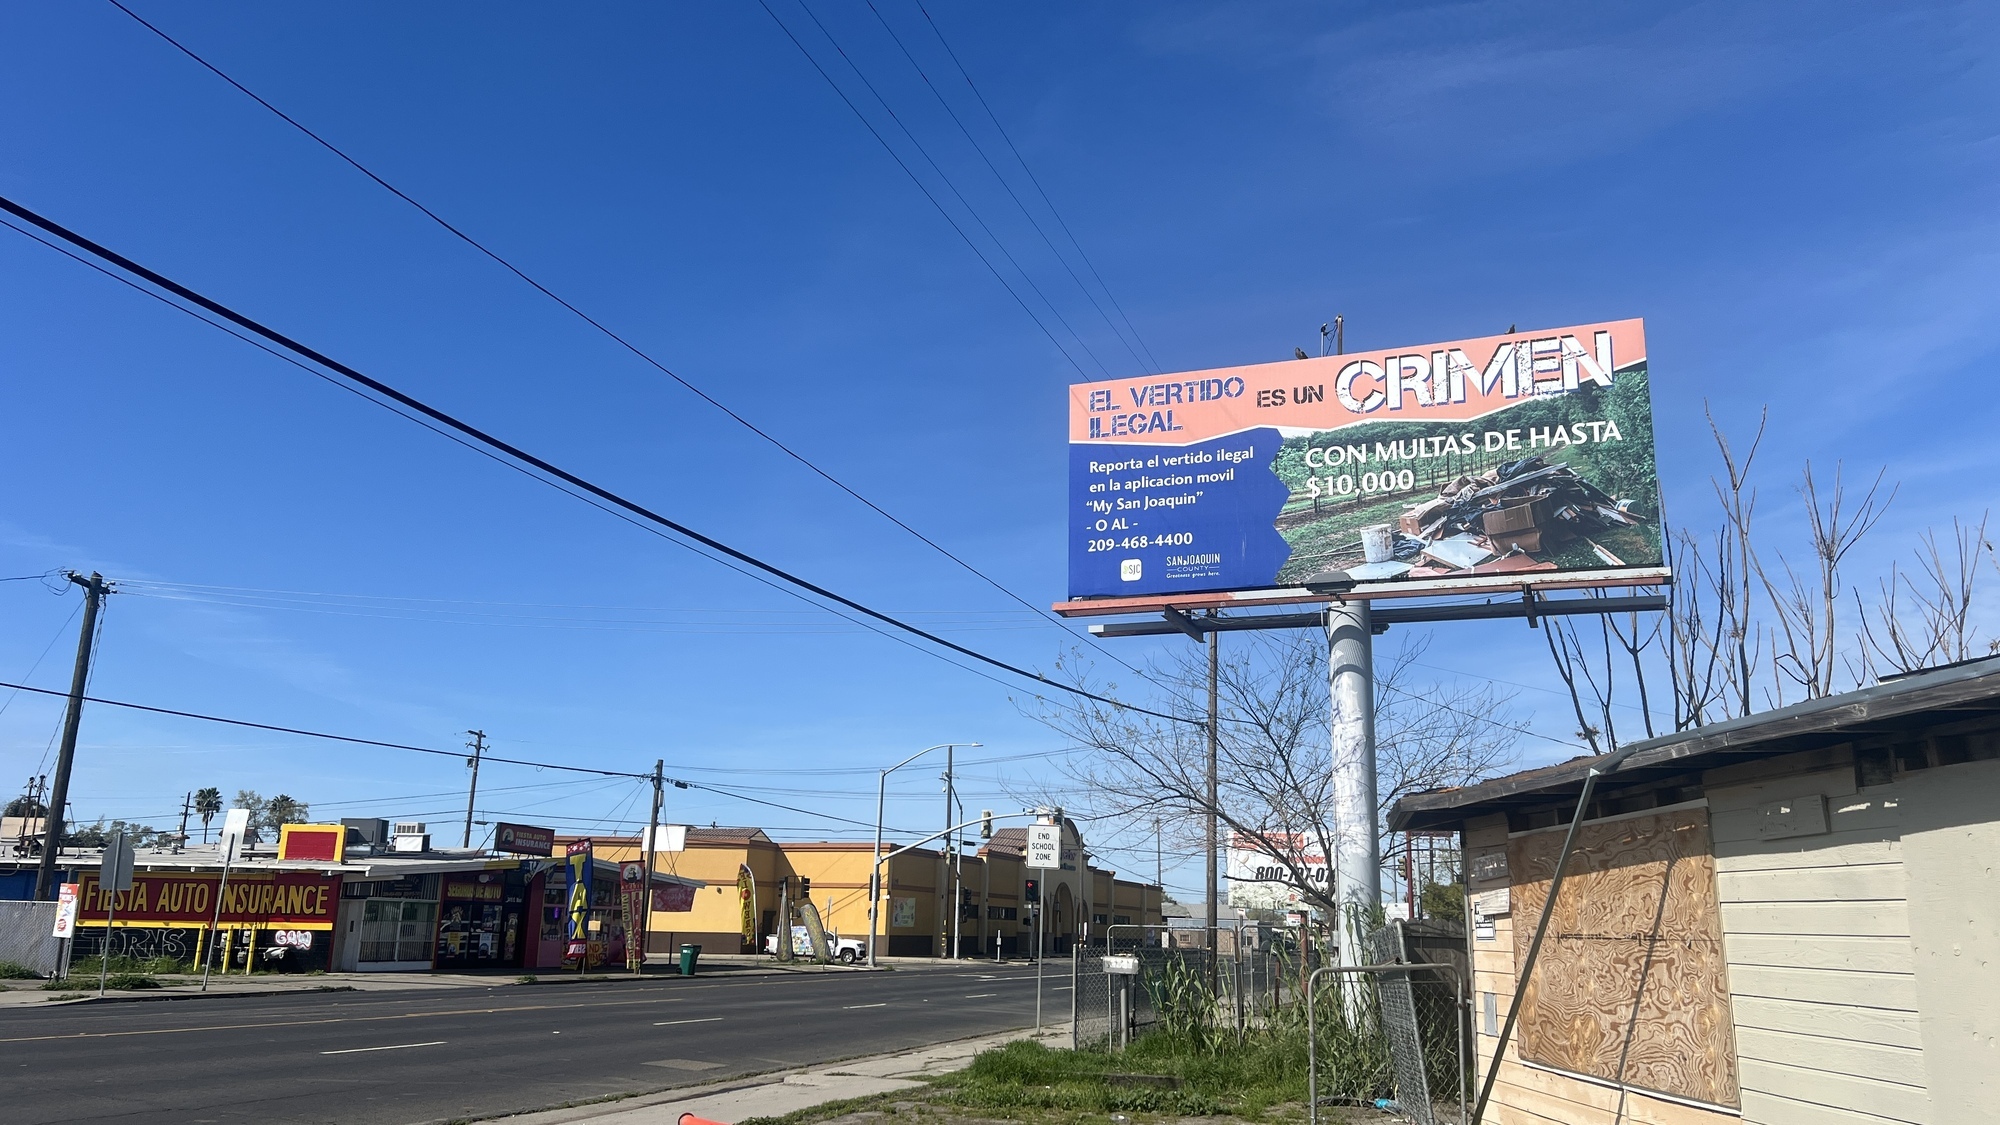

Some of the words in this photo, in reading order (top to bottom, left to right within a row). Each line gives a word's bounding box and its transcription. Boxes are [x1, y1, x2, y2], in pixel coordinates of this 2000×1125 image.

[1335, 330, 1616, 413] CRIMEN
[1089, 390, 1121, 412] EL
[1130, 376, 1245, 408] VERTIDO
[1257, 389, 1286, 408] ES
[1293, 384, 1324, 404] UN
[1089, 410, 1183, 439] ILEGAL
[1306, 442, 1367, 468] CON
[1375, 432, 1476, 462] MULTAS
[1485, 427, 1522, 453] DE
[1530, 420, 1622, 448] HASTA
[1089, 458, 1143, 475] Reporta
[1147, 453, 1159, 467] el
[1163, 449, 1212, 465] vertido
[1216, 446, 1254, 464] ilegal
[1089, 482, 1106, 493] en
[1109, 478, 1121, 491] la
[1124, 473, 1193, 494] aplicacion
[1196, 469, 1234, 484] movil
[1306, 469, 1414, 499] $10,000
[1086, 499, 1113, 515] “My
[1117, 496, 1141, 511] San
[1144, 491, 1204, 511] Joaquin”
[1095, 518, 1108, 532] O
[1111, 517, 1129, 531] AL
[1087, 533, 1193, 553] 209-468-4400
[1128, 563, 1141, 576] SJC
[1166, 555, 1183, 567] SAN
[1186, 553, 1221, 566] JOAQUIN
[1177, 565, 1209, 573] COUNTY
[515, 838, 551, 850] INSURANCE
[1031, 842, 1056, 851] SCHOOL
[1037, 832, 1050, 840] END
[1035, 853, 1051, 861] ZONE
[84, 880, 148, 912] FIESTA
[155, 882, 210, 912] AUTO
